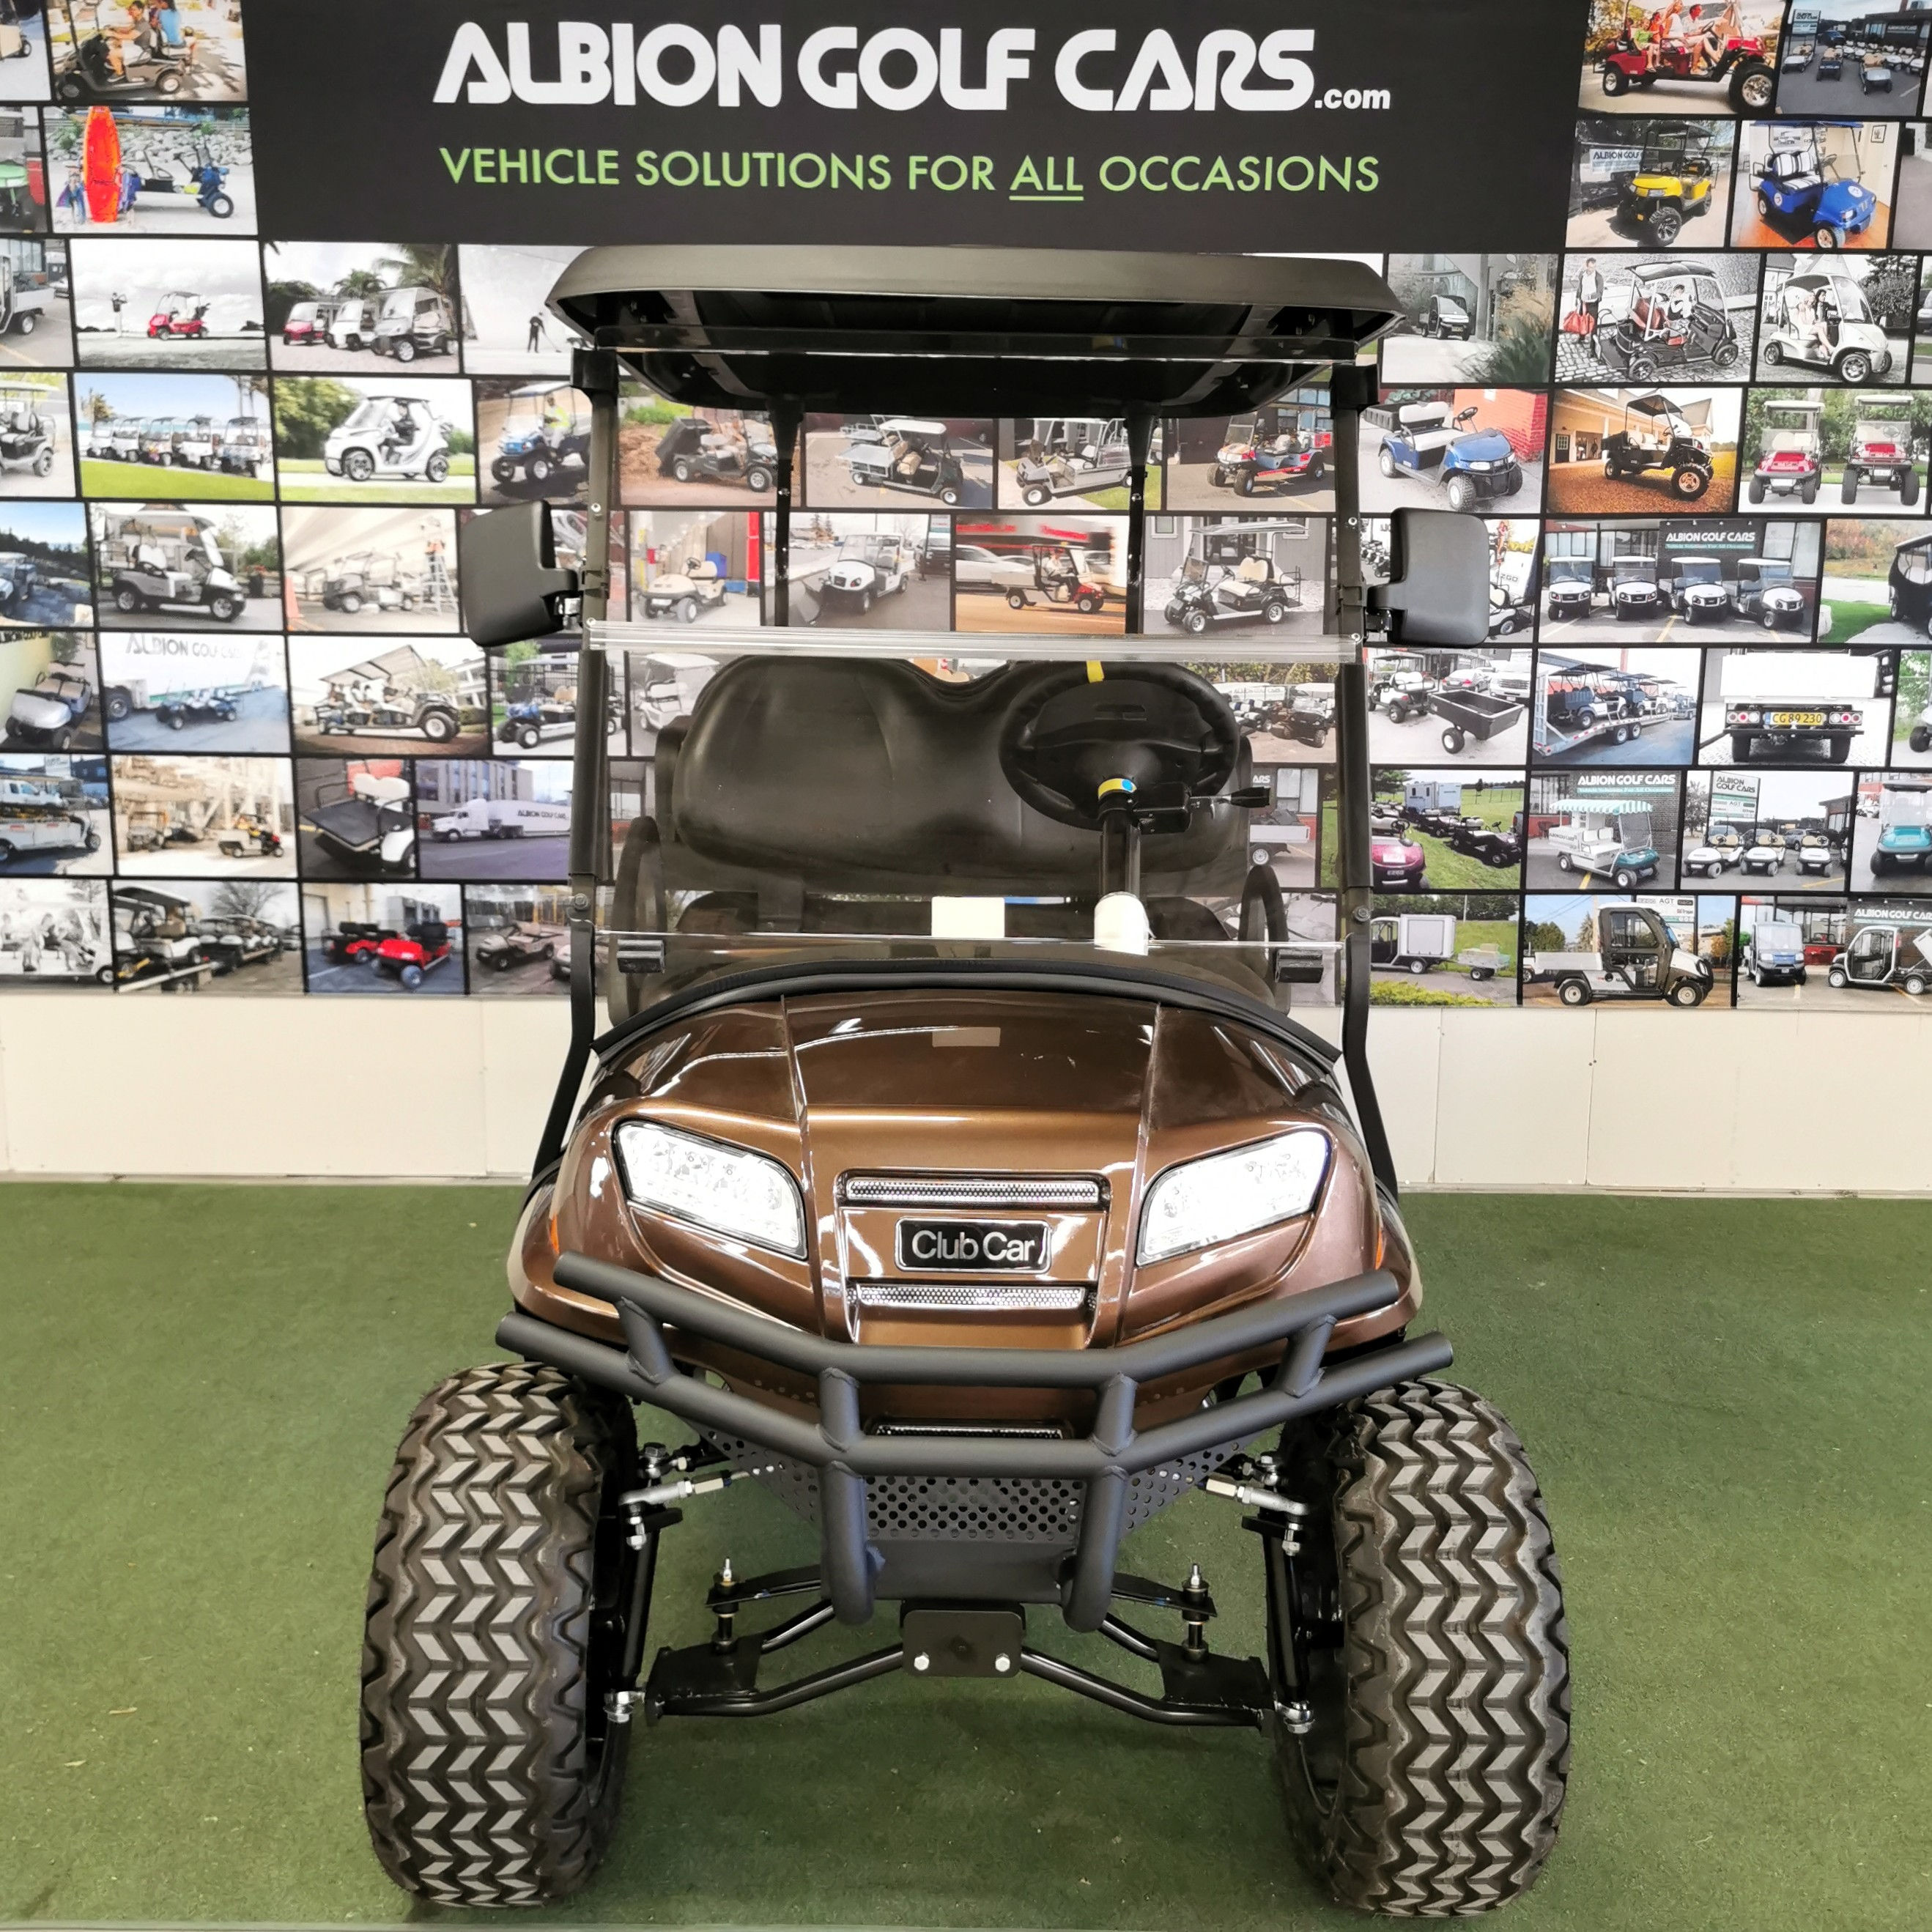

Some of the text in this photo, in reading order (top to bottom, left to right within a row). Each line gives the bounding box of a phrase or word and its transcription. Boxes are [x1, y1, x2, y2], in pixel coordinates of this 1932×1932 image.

[433, 21, 782, 107] ALBION
[797, 26, 1035, 111] GOLF
[1593, 151, 1640, 160] ALBION GOLF
[440, 147, 1379, 192] VEHICLE SOLUTIONS FOR ALL OCCASIONS
[1666, 532, 1755, 542] ALBION GOLF CARS
[1773, 714, 1822, 723] CG 89 230
[1252, 775, 1270, 783] ARS
[1578, 774, 1676, 786] ALBION GOLF CARS
[1717, 776, 1744, 785] ALBION
[1716, 782, 1755, 793] GOLF CARS
[1854, 908, 1932, 920] ALBION GOLF CAR
[911, 1229, 1035, 1262] Club Car
